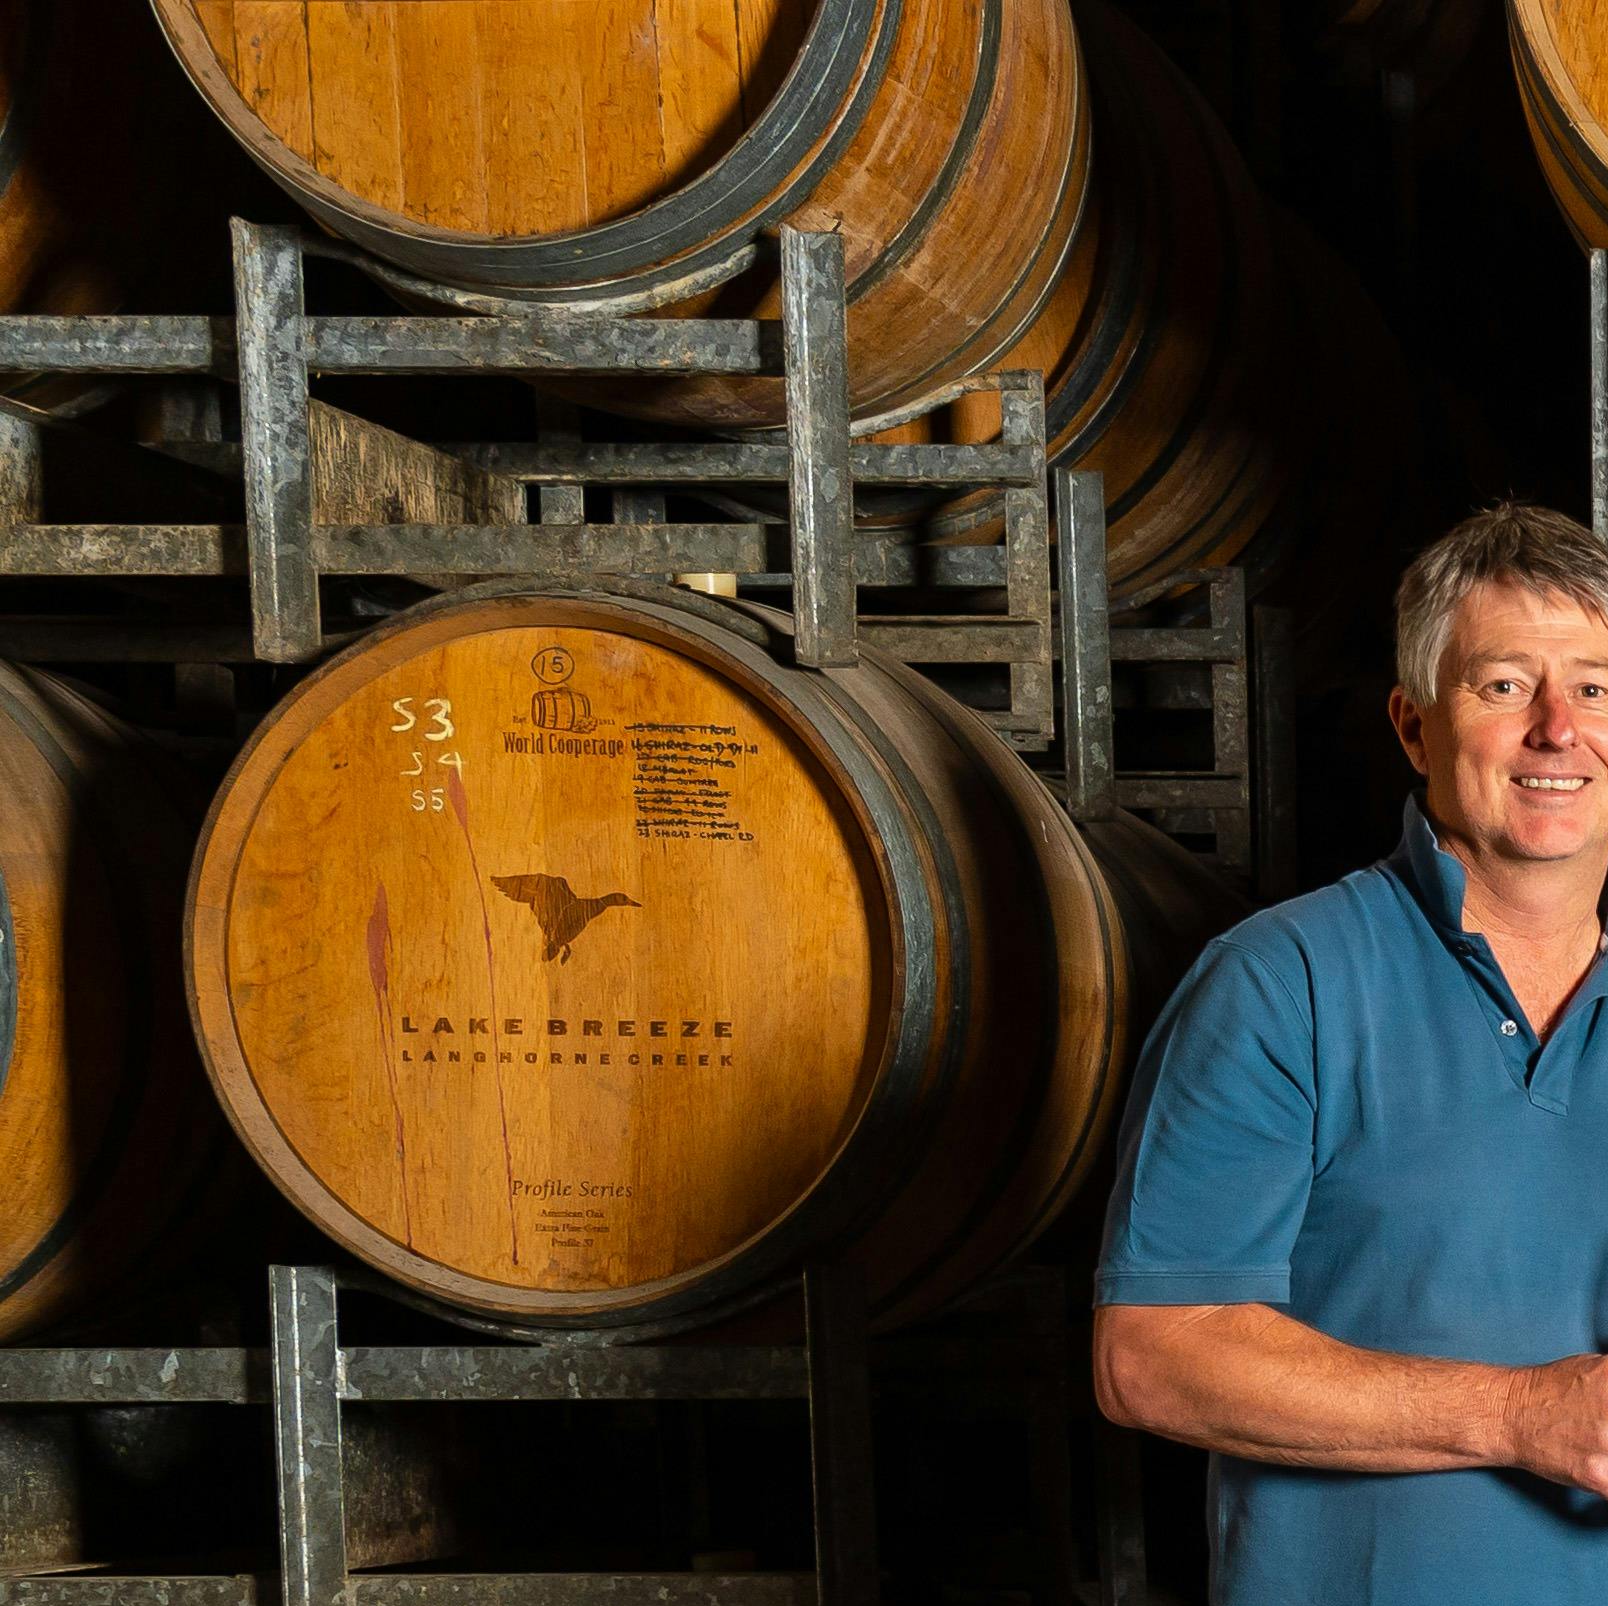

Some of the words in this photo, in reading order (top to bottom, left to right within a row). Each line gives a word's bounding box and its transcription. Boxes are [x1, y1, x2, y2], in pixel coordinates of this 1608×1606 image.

[540, 656, 564, 674] 15
[503, 732, 544, 754] World
[549, 734, 624, 758] Cooperage
[412, 789, 444, 811] S5
[402, 1017, 523, 1036] LAKE
[547, 1019, 732, 1038] BREEZE
[402, 1050, 610, 1065] LANGHORNE
[628, 1053, 733, 1066] CREEK
[512, 1180, 571, 1200] Profile
[579, 1181, 633, 1197] Series
